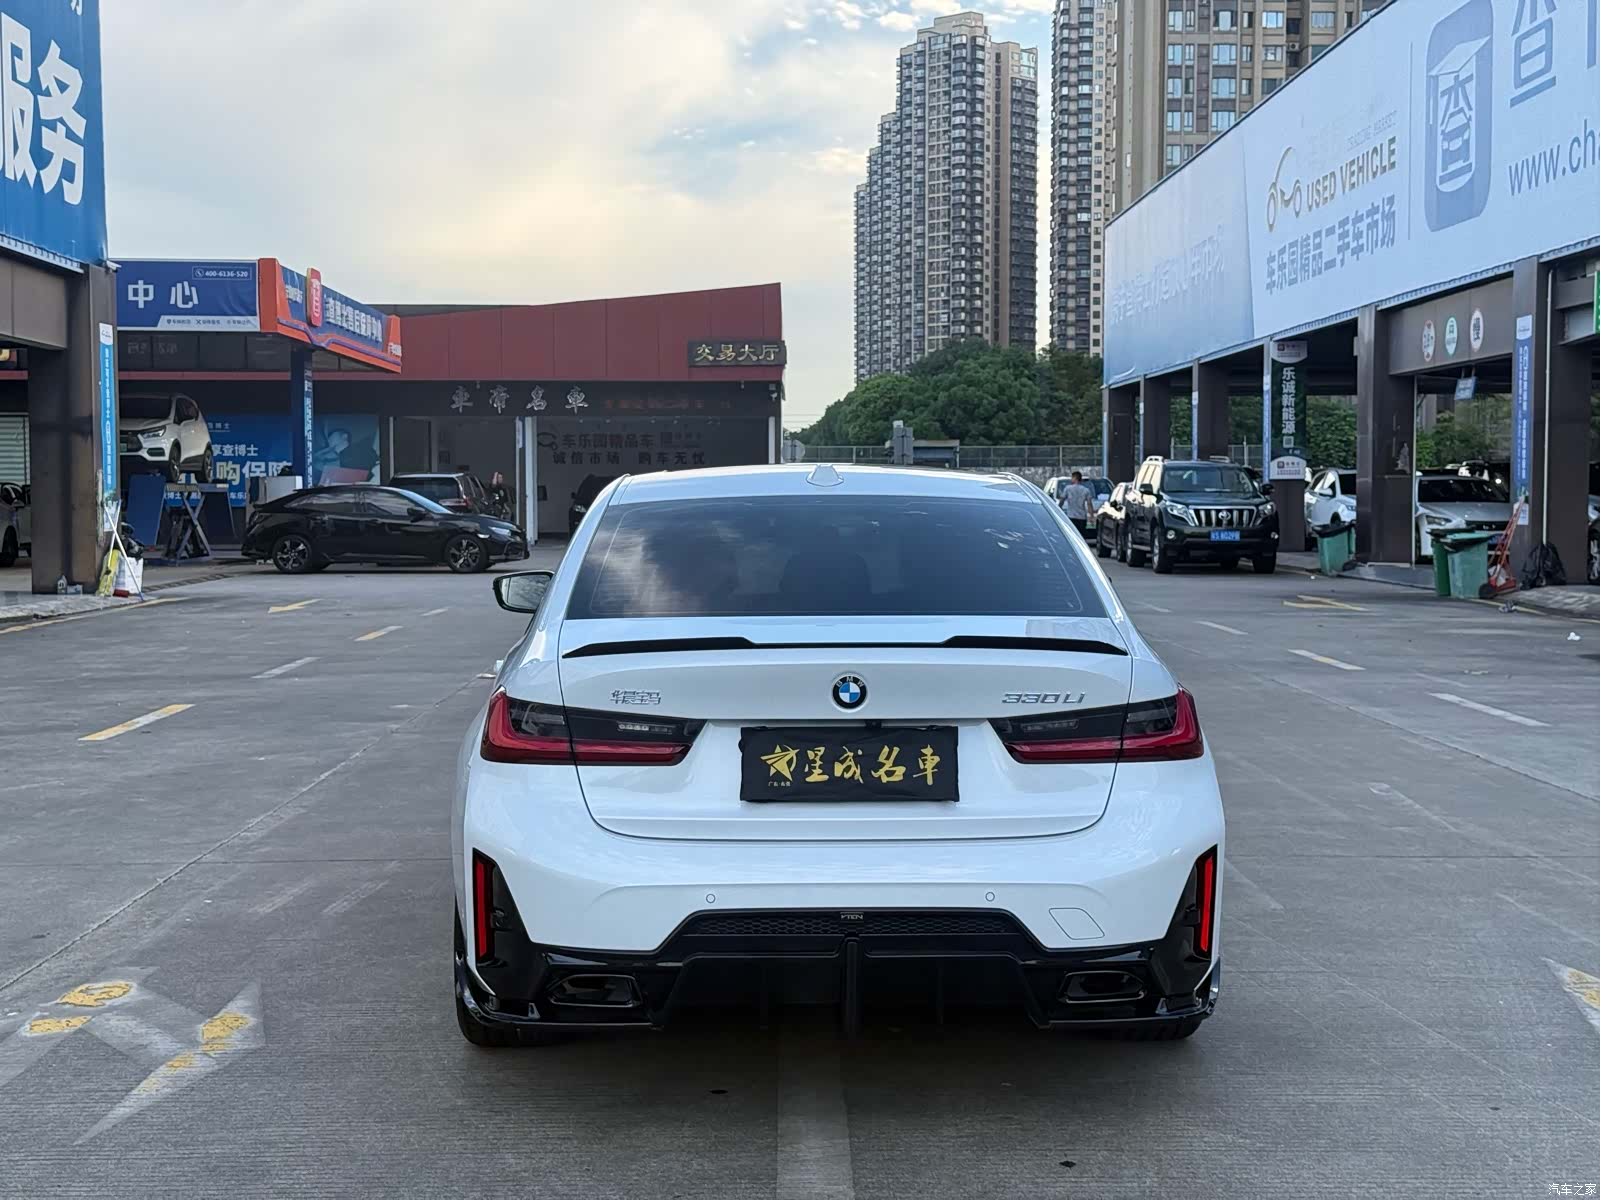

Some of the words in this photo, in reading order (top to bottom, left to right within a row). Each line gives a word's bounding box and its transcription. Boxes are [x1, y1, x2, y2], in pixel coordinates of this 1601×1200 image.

[1508, 0, 1597, 108] 查
[1307, 170, 1337, 212] USED
[1340, 136, 1397, 195] VEHICLE
[1508, 118, 1600, 196] www.ch
[1265, 194, 1396, 295] 车乐园精品二手车市场
[127, 280, 199, 309] 中心
[694, 344, 780, 363] 交易大厅
[1281, 366, 1297, 433] 乐诚新能源
[553, 451, 620, 465] 诚信市场
[638, 451, 706, 465] 购车无忧
[561, 432, 655, 449] 车乐园精品车
[610, 690, 662, 705] 华晨宝马
